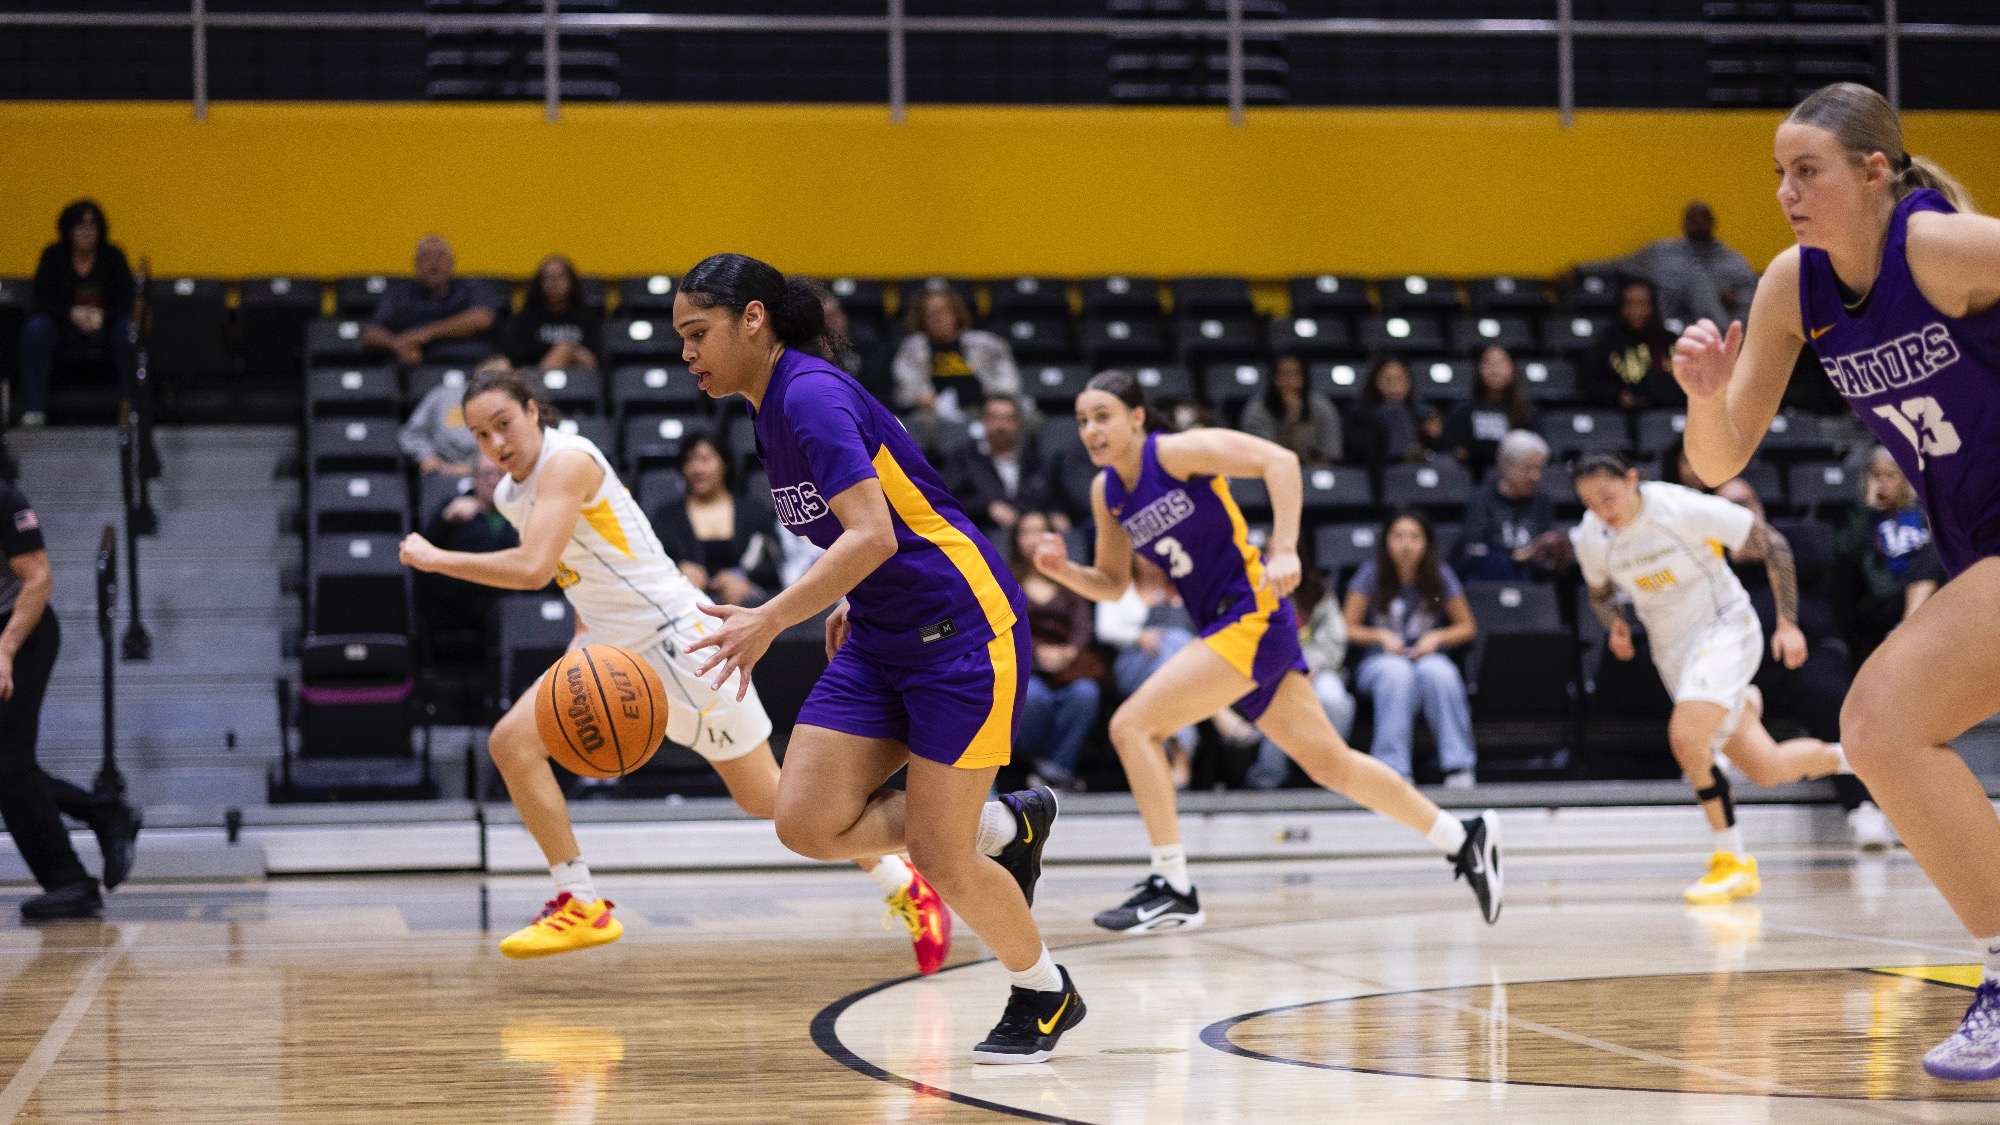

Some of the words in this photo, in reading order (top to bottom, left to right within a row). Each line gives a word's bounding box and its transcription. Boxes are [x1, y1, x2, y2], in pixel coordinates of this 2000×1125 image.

[1820, 322, 1961, 397] GATORS
[1872, 396, 1962, 471] 13
[1153, 536, 1194, 579] 3
[942, 623, 952, 633] M
[566, 663, 606, 755] Wilson
